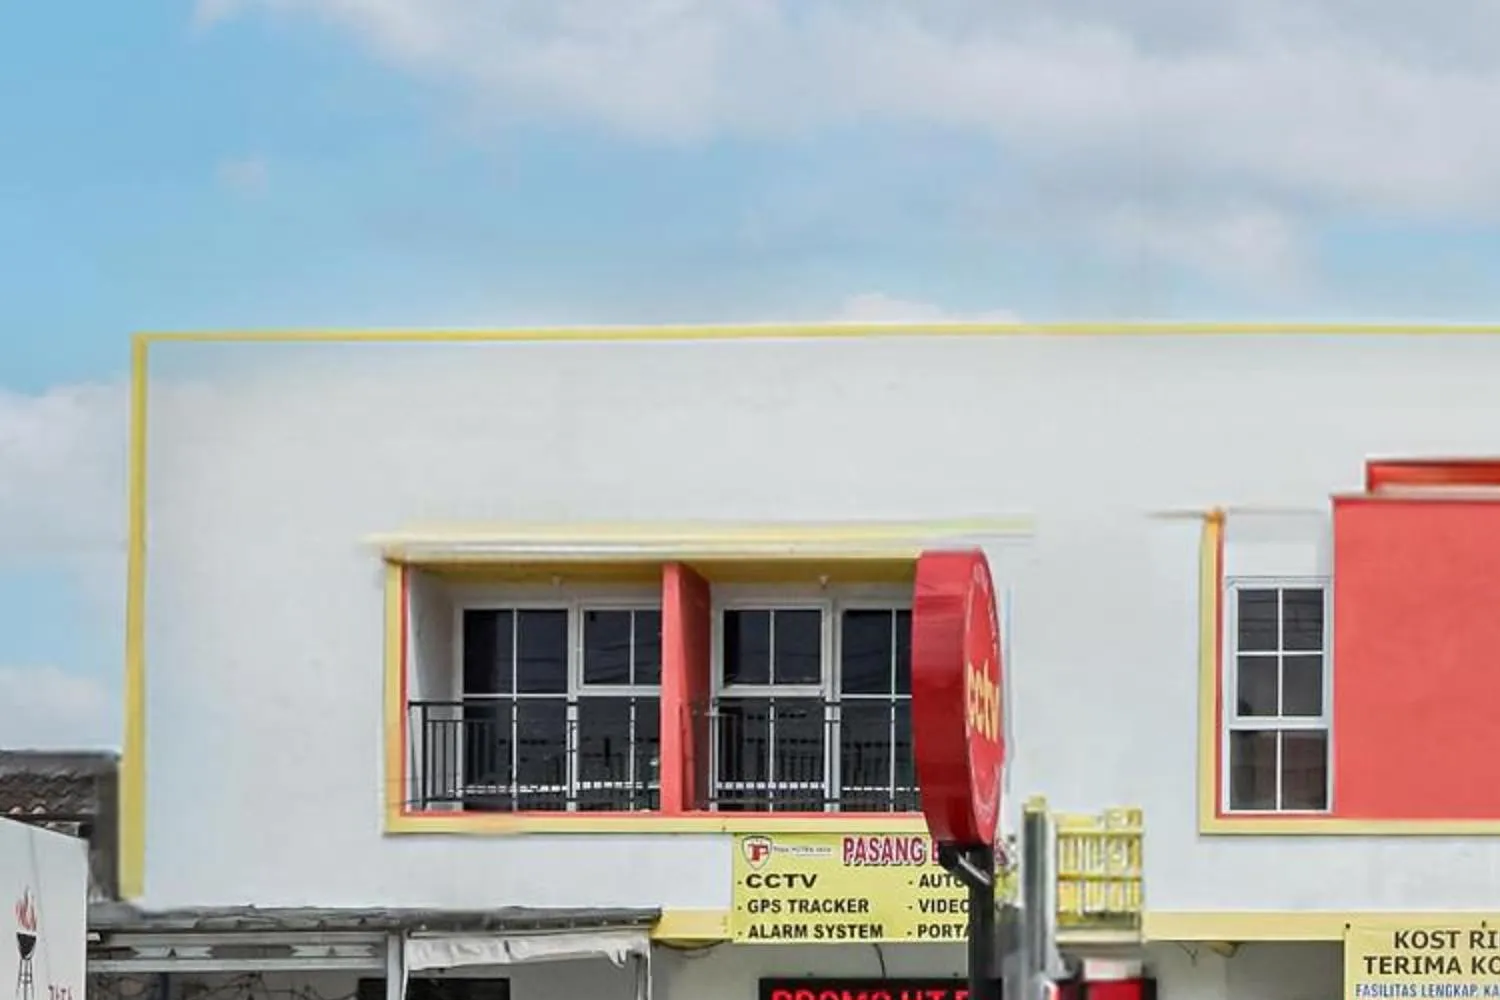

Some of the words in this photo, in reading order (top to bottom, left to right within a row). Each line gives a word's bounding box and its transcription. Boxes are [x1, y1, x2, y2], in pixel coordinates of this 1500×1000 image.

[842, 836, 928, 867] PASANG
[745, 874, 817, 889] CCTV
[747, 900, 782, 914] GPS
[788, 900, 870, 914] TRACKER
[748, 925, 809, 939] ALARM
[813, 925, 883, 939] SYSTEM
[1394, 930, 1461, 949] KOST
[1364, 956, 1462, 975] TERIMA
[1355, 984, 1418, 999] FASILITAS
